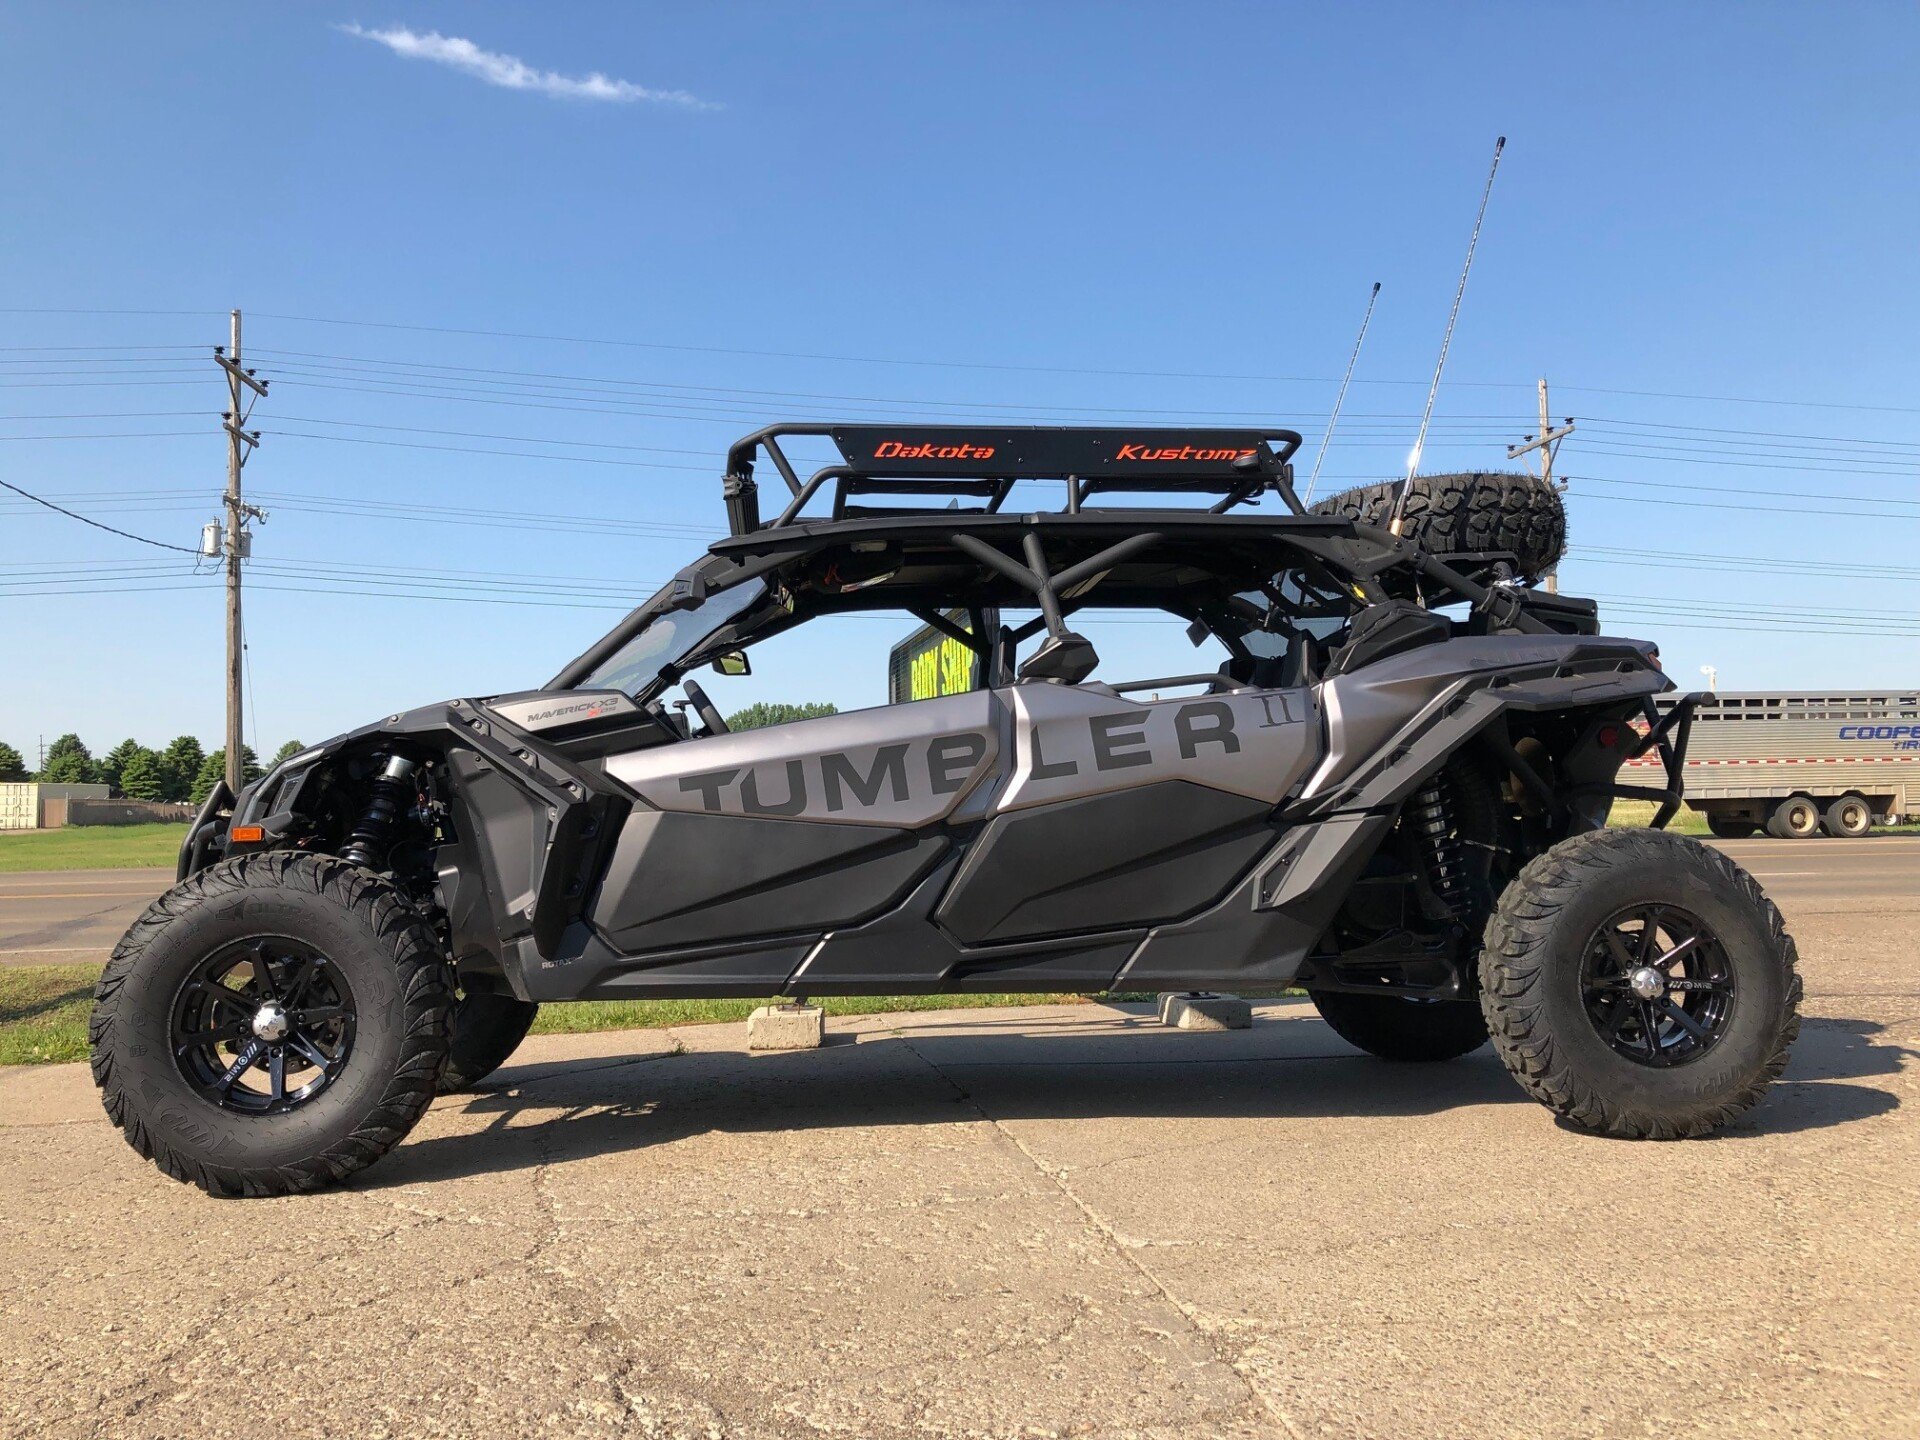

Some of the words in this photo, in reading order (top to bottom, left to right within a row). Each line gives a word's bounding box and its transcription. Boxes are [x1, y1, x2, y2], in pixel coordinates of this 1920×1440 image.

[873, 442, 995, 459] Dakota
[527, 702, 597, 723] MAVERICK
[598, 697, 619, 708] X3
[1251, 692, 1305, 728] II
